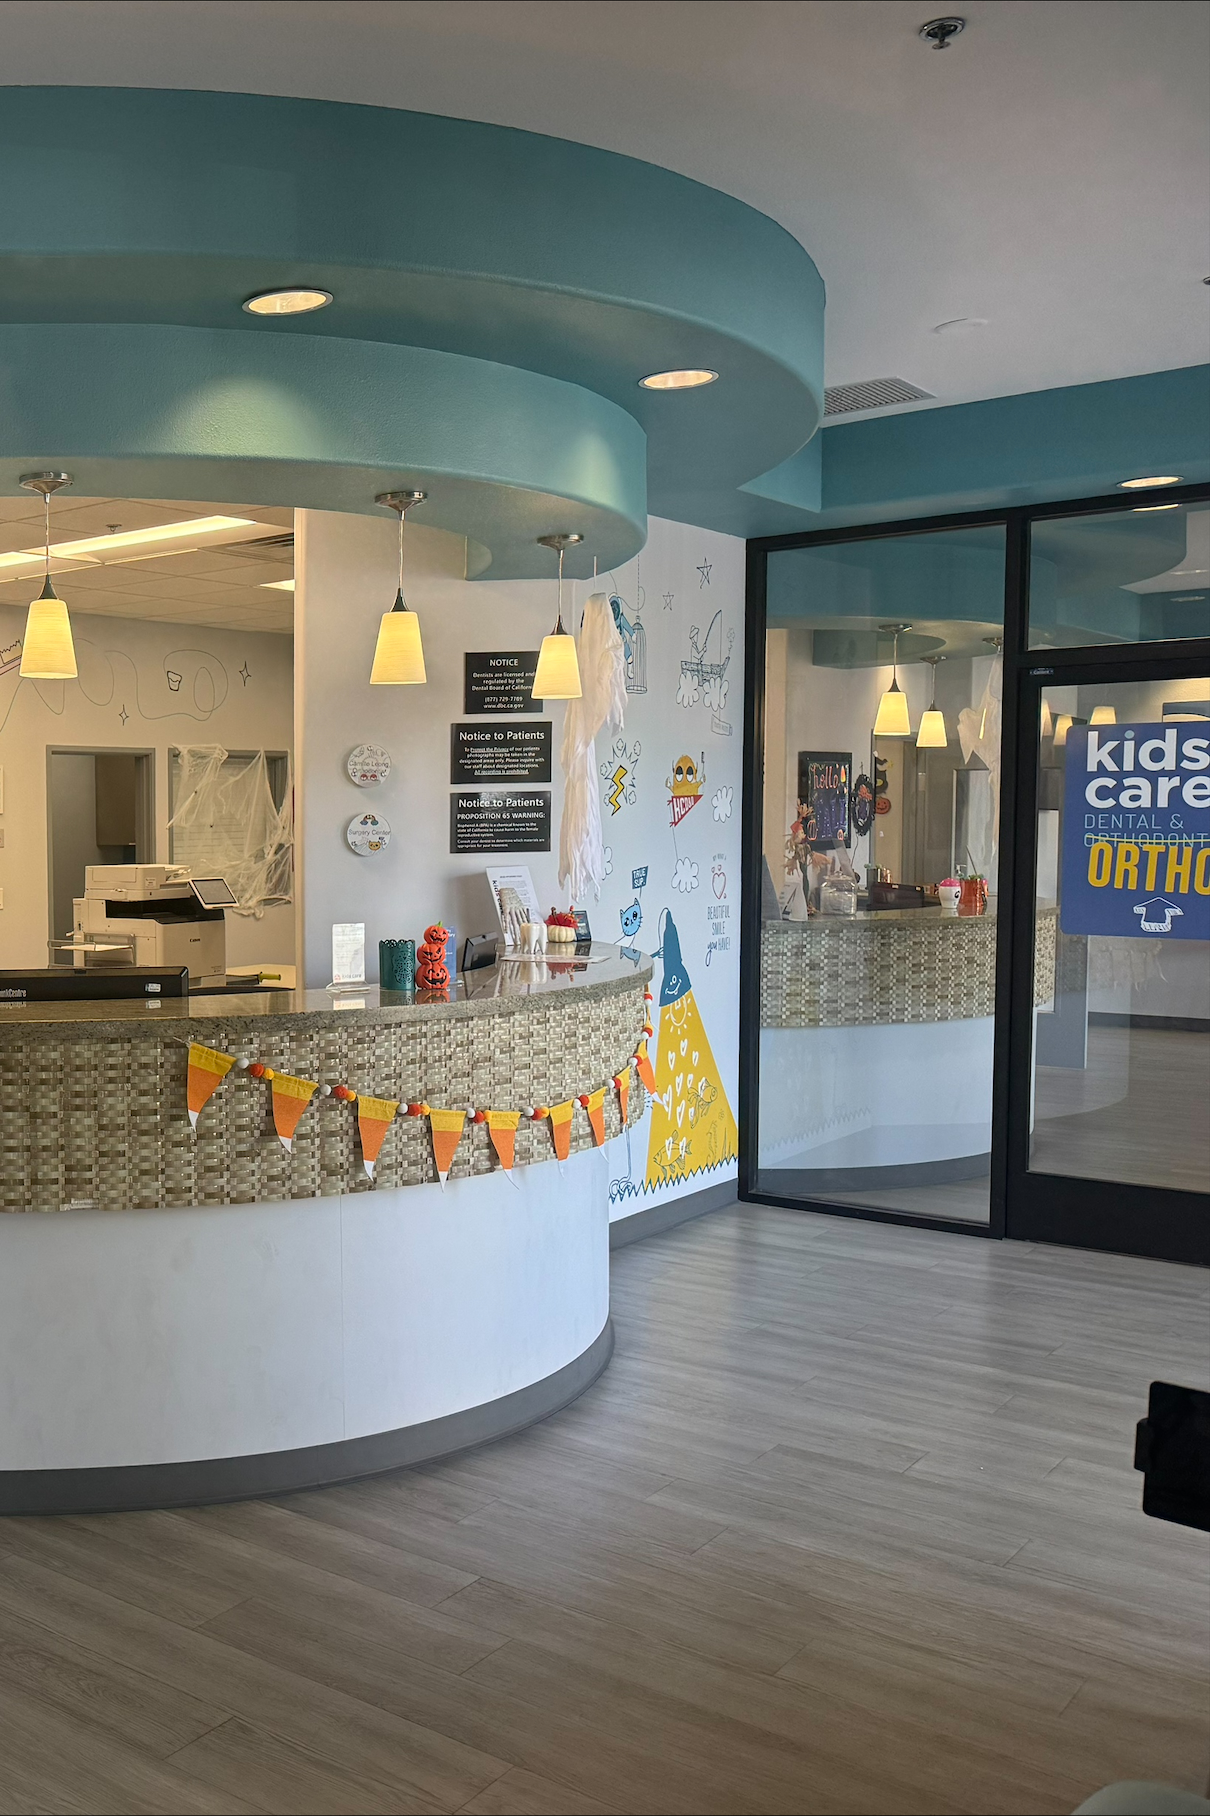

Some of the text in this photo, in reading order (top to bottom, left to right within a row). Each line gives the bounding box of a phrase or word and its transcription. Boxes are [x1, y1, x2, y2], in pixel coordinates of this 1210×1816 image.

[460, 732, 491, 740] Notice
[507, 731, 544, 740] Patients
[1086, 728, 1210, 772] kids
[810, 764, 838, 789] hello
[1085, 776, 1210, 809] care
[459, 799, 490, 808] Notice
[506, 798, 544, 807] Patients
[1085, 814, 1184, 829] DENTAL &
[1088, 842, 1210, 895] ORTHO
[708, 905, 730, 920] BEAUTIFUL
[712, 921, 725, 935] SMILE
[706, 937, 730, 967] you HAVE!
